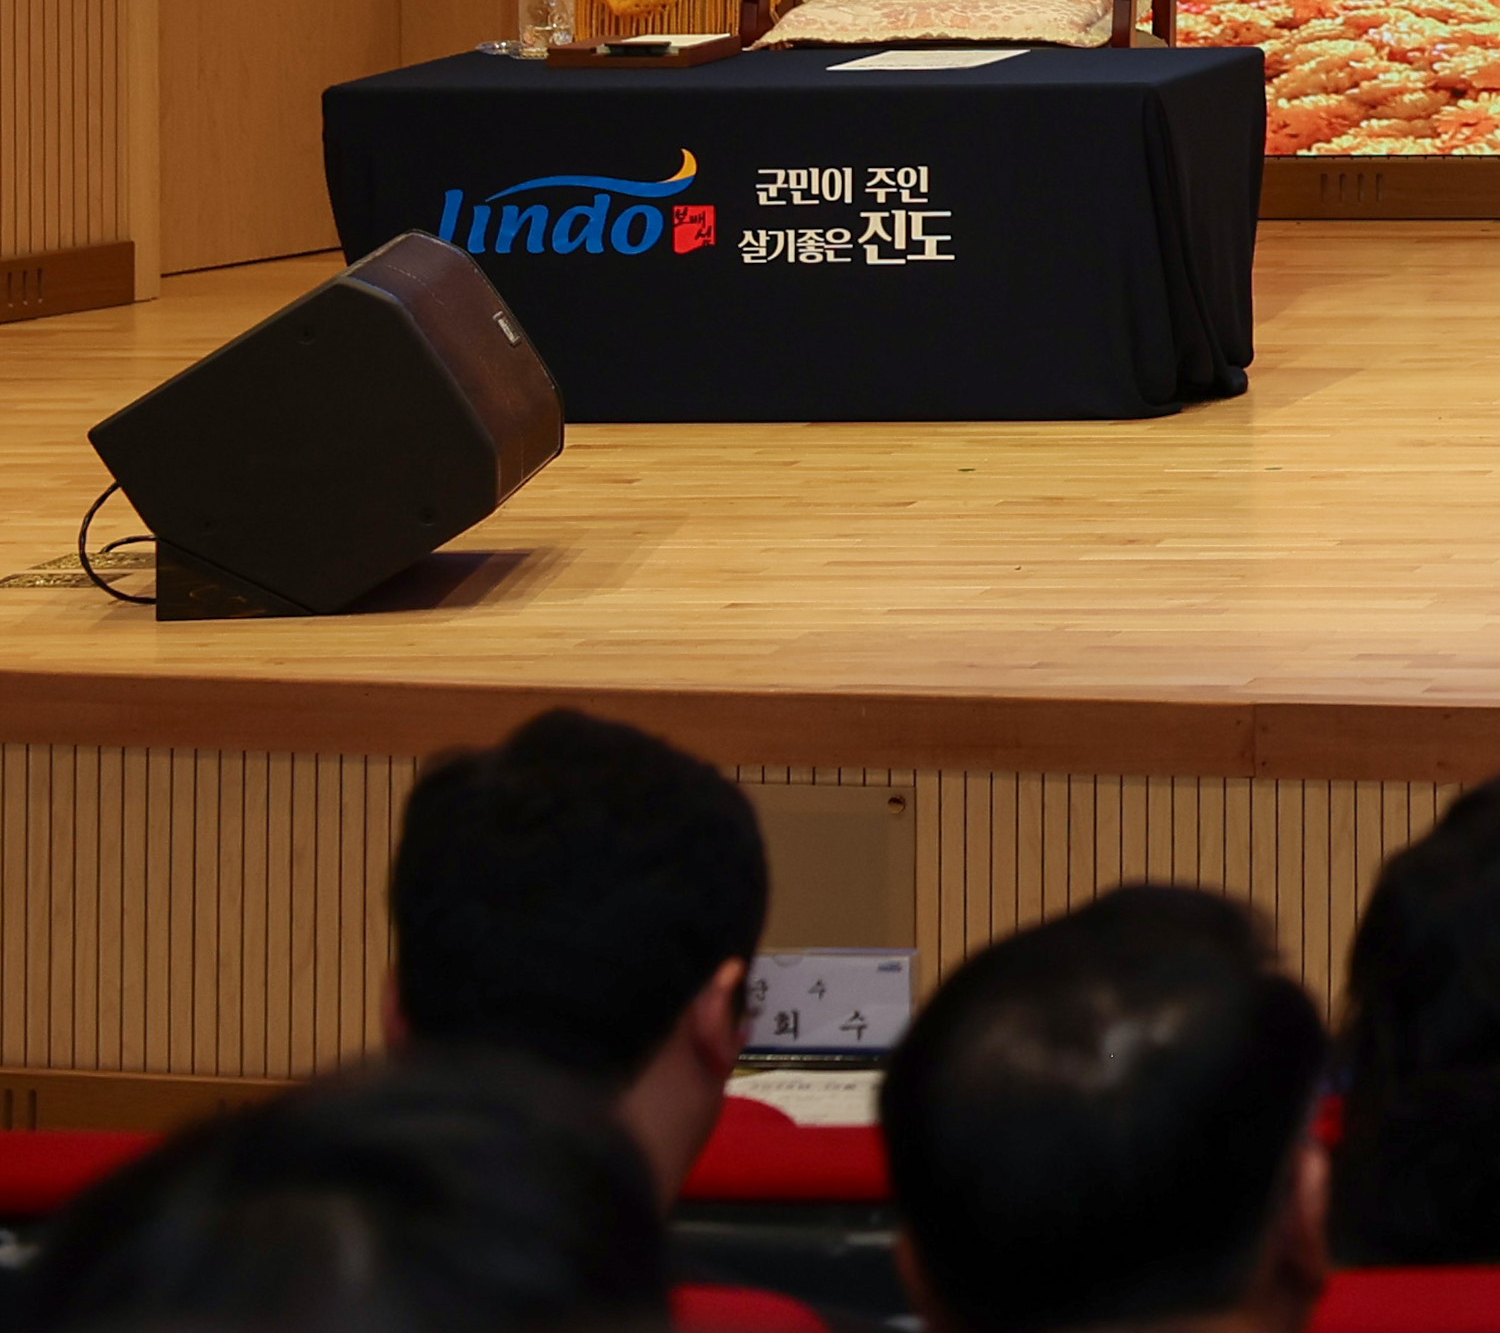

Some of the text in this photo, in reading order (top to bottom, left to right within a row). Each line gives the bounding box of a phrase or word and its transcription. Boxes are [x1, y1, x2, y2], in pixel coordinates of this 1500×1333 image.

[755, 165, 930, 206] 군민이 주인
[737, 208, 957, 265] 살기좋은 진도
